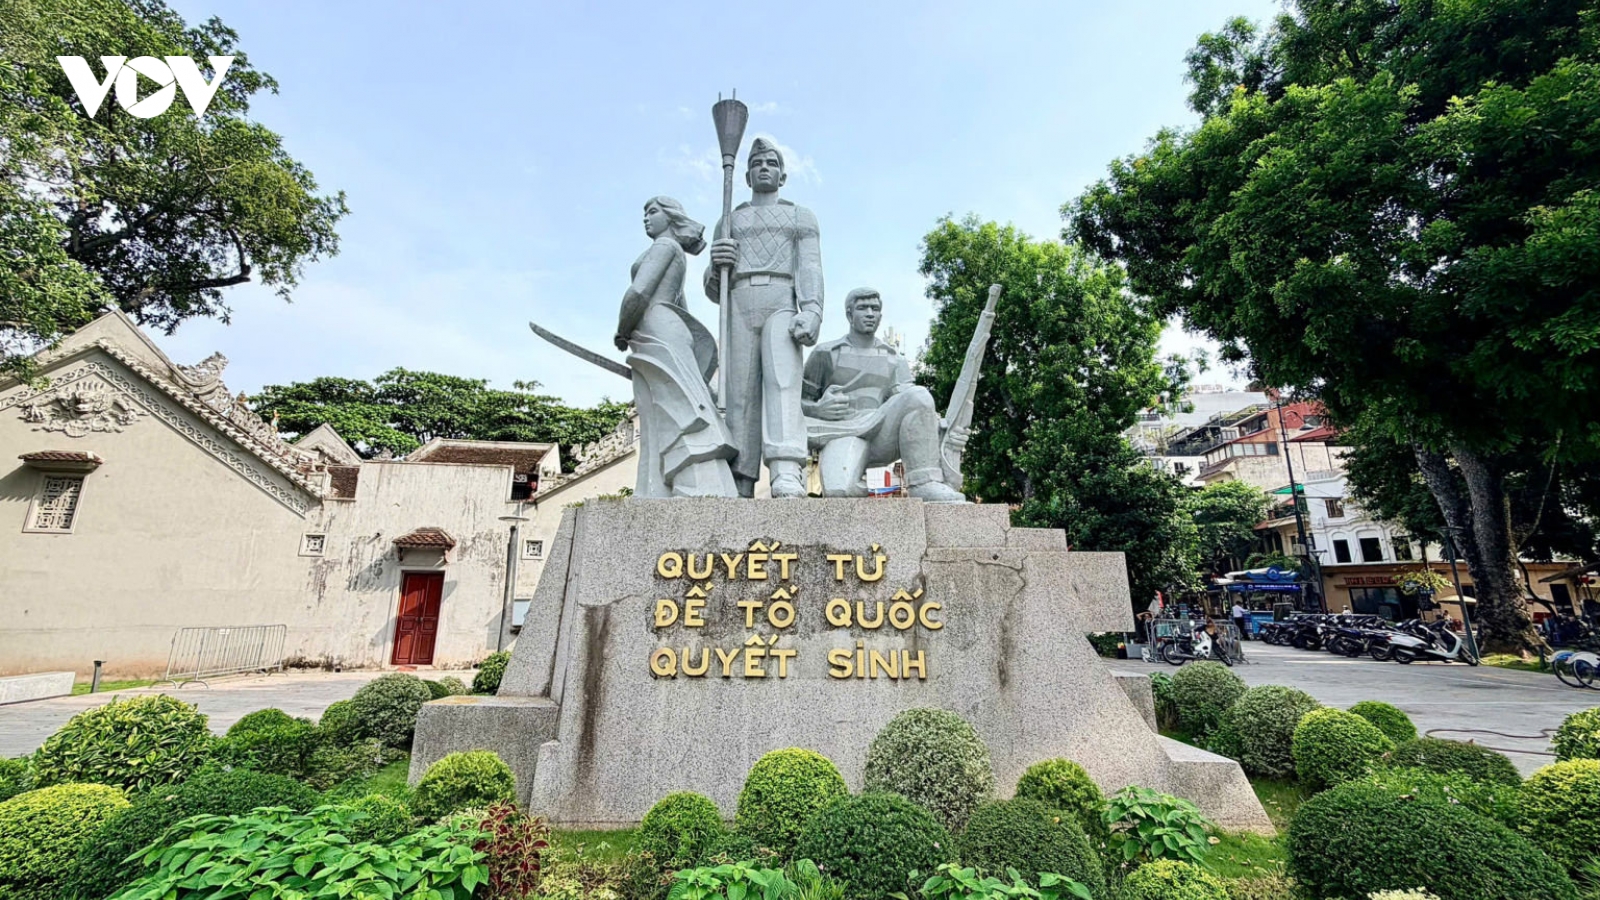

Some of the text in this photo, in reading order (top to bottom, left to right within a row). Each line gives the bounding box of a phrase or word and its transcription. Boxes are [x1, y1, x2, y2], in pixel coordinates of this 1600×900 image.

[656, 541, 887, 582] QUYẾT TỬ
[825, 588, 943, 630] QUỐC
[650, 634, 797, 679] QUYẾT
